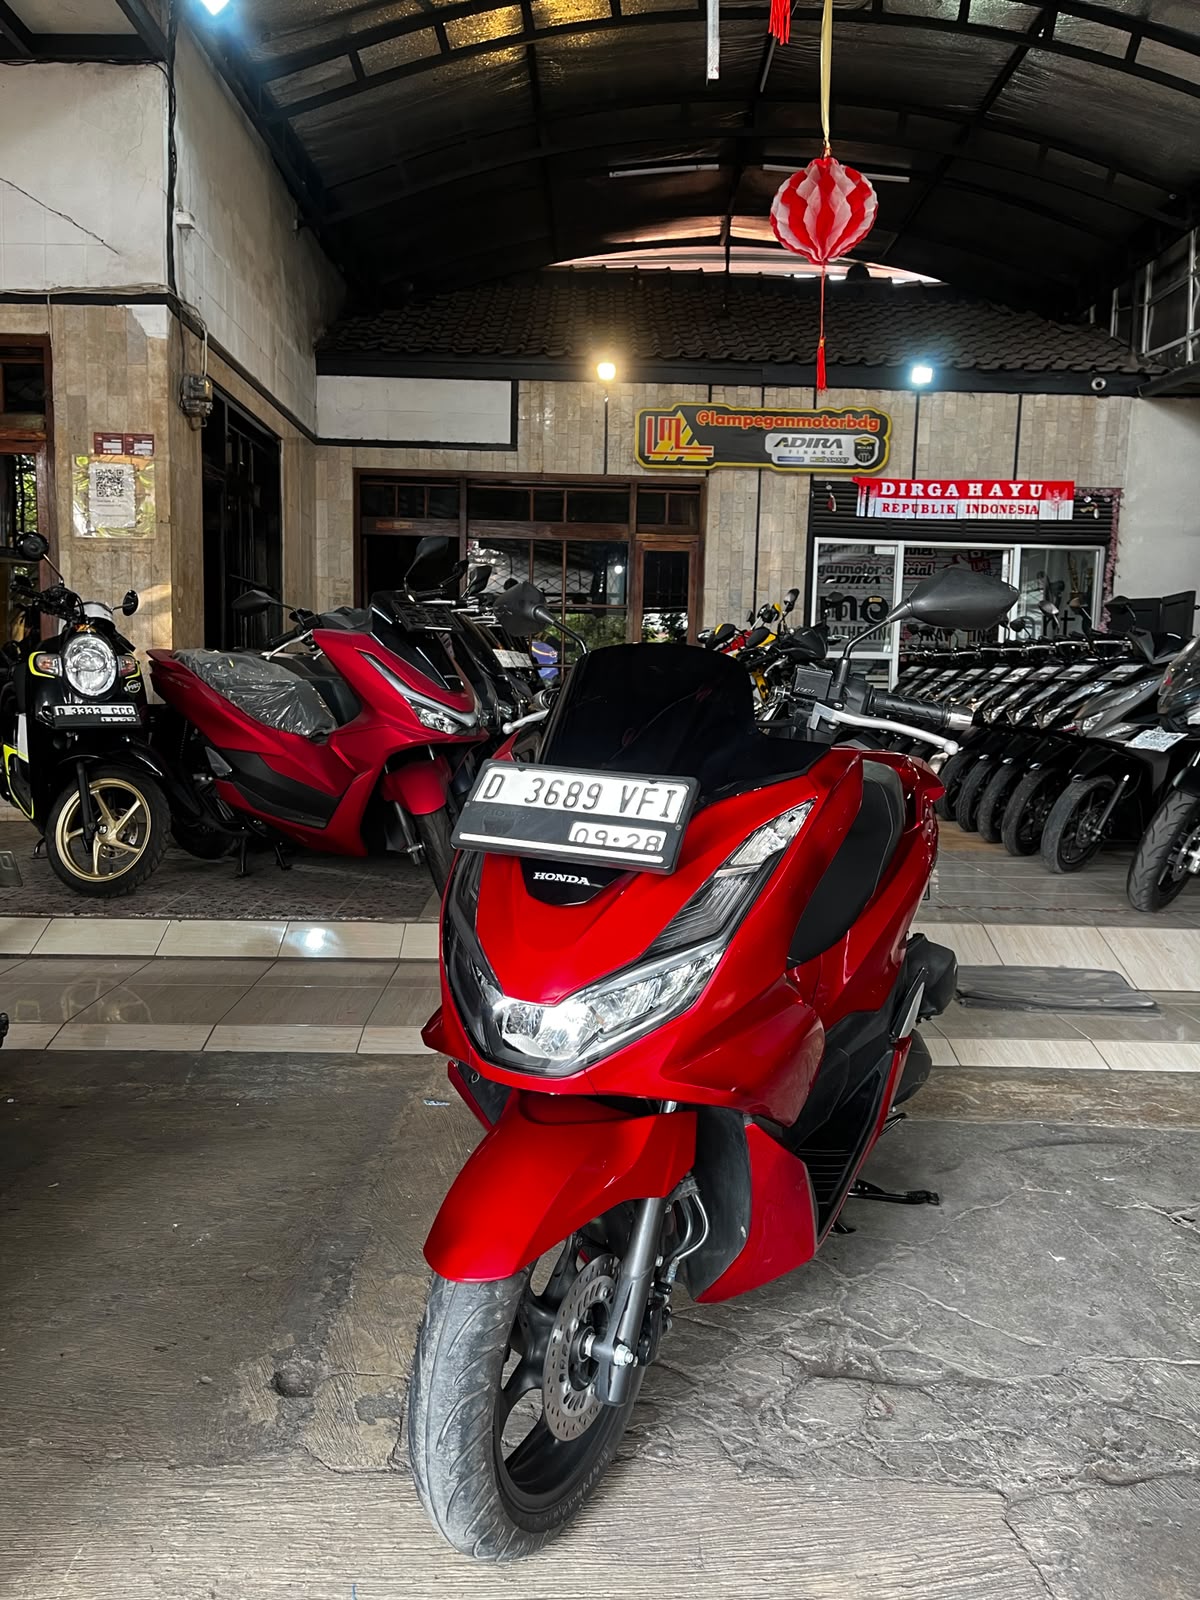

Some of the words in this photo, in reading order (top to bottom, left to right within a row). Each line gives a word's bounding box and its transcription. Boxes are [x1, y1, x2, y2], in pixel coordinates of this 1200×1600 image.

[697, 411, 880, 432] @lampeganmotorbdg
[773, 437, 842, 449] ADIRA
[882, 502, 956, 514] REPUBLIK
[965, 503, 1040, 515] INDONESIA
[482, 773, 506, 800] D
[524, 777, 604, 810] 3689
[618, 785, 678, 818] VFI
[533, 871, 590, 886] HONDA
